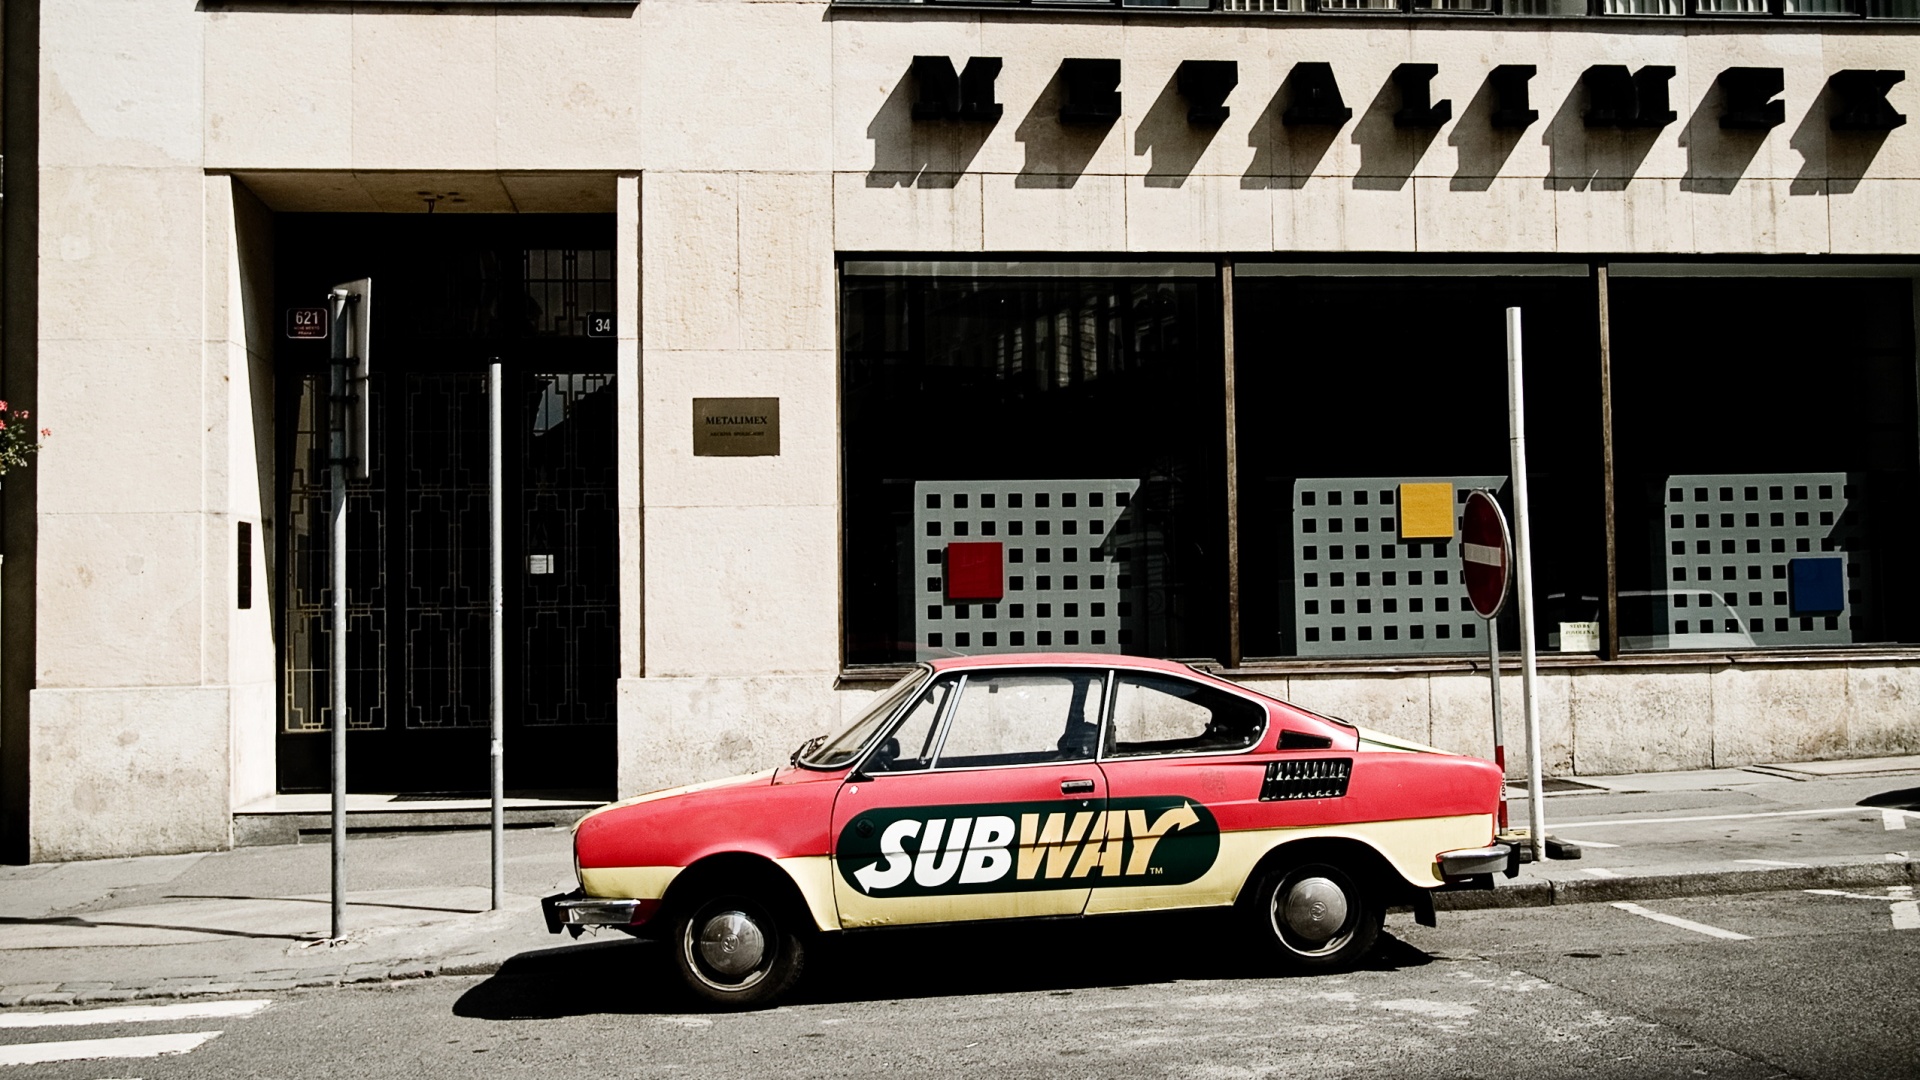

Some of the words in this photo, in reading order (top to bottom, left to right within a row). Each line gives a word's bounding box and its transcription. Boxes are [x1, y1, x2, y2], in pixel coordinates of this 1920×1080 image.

[911, 55, 1907, 131] METALIMEX
[295, 311, 319, 325] 621
[595, 318, 611, 332] 34
[705, 416, 768, 425] METALIMEX
[853, 801, 1200, 894] SUBWAY
[1150, 867, 1163, 875] TM
